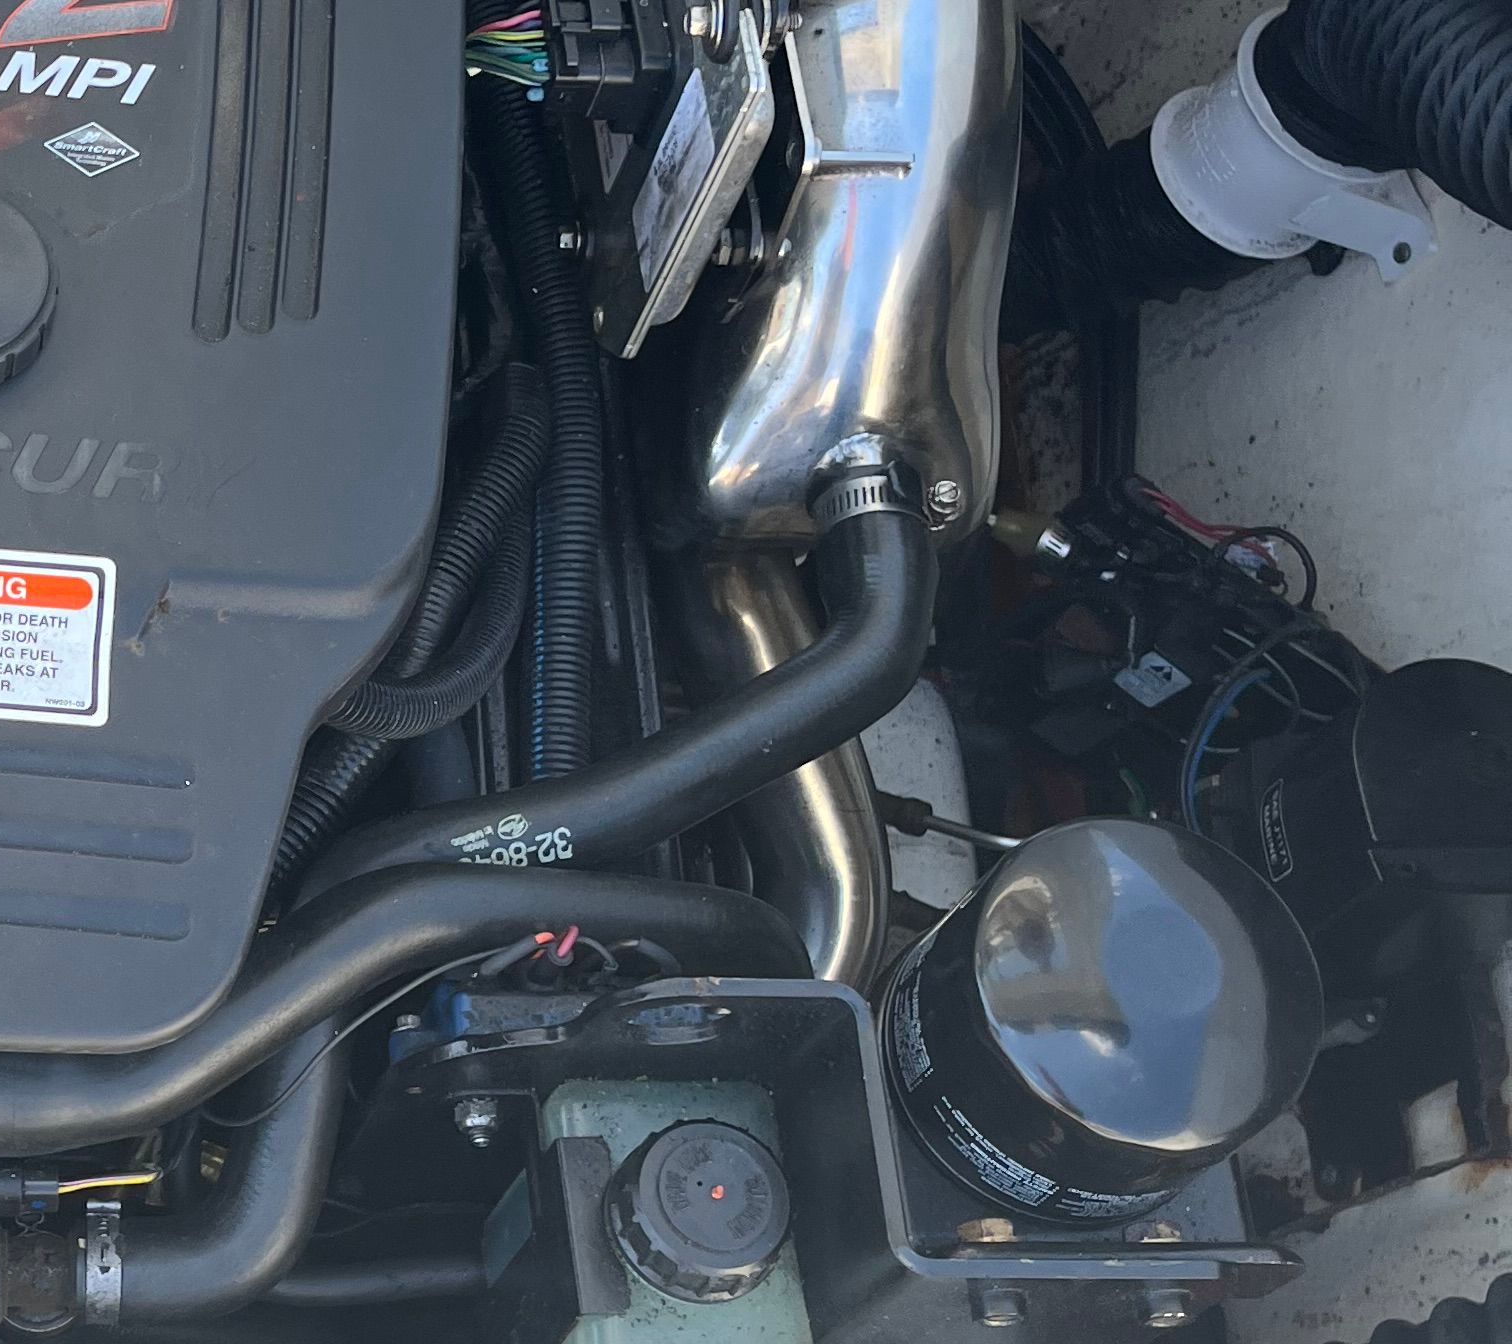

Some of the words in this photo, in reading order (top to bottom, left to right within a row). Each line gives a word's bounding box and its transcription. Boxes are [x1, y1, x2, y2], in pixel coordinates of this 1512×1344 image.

[54, 141, 127, 156] SmartCraft
[18, 614, 69, 629] DEATH
[20, 648, 64, 664] FUEL.
[39, 666, 59, 679] AT
